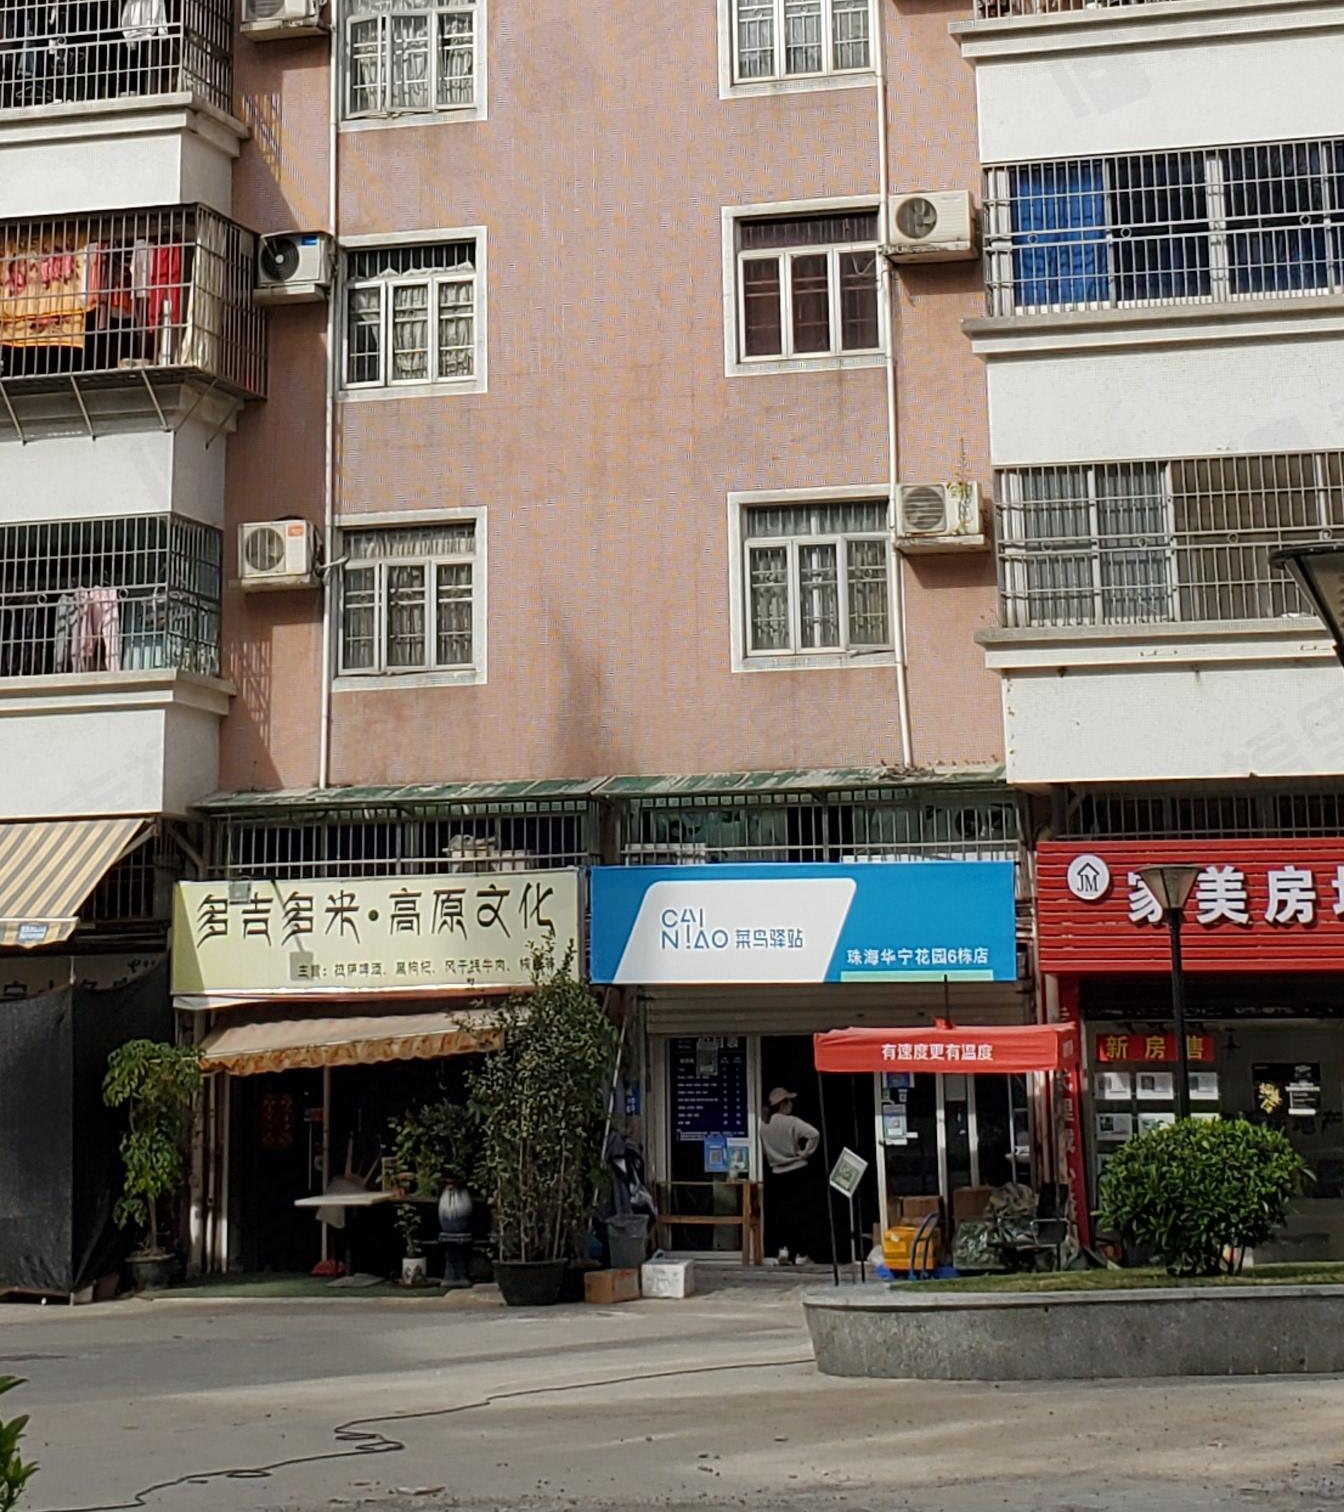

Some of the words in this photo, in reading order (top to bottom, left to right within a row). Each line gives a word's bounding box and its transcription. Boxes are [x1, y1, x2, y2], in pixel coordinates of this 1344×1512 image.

[1077, 874, 1099, 893] JM
[735, 928, 804, 950] 菜鸟驿站
[847, 947, 989, 966] 珠海华宁花园6栋店
[881, 1043, 993, 1061] 有速度更有温度
